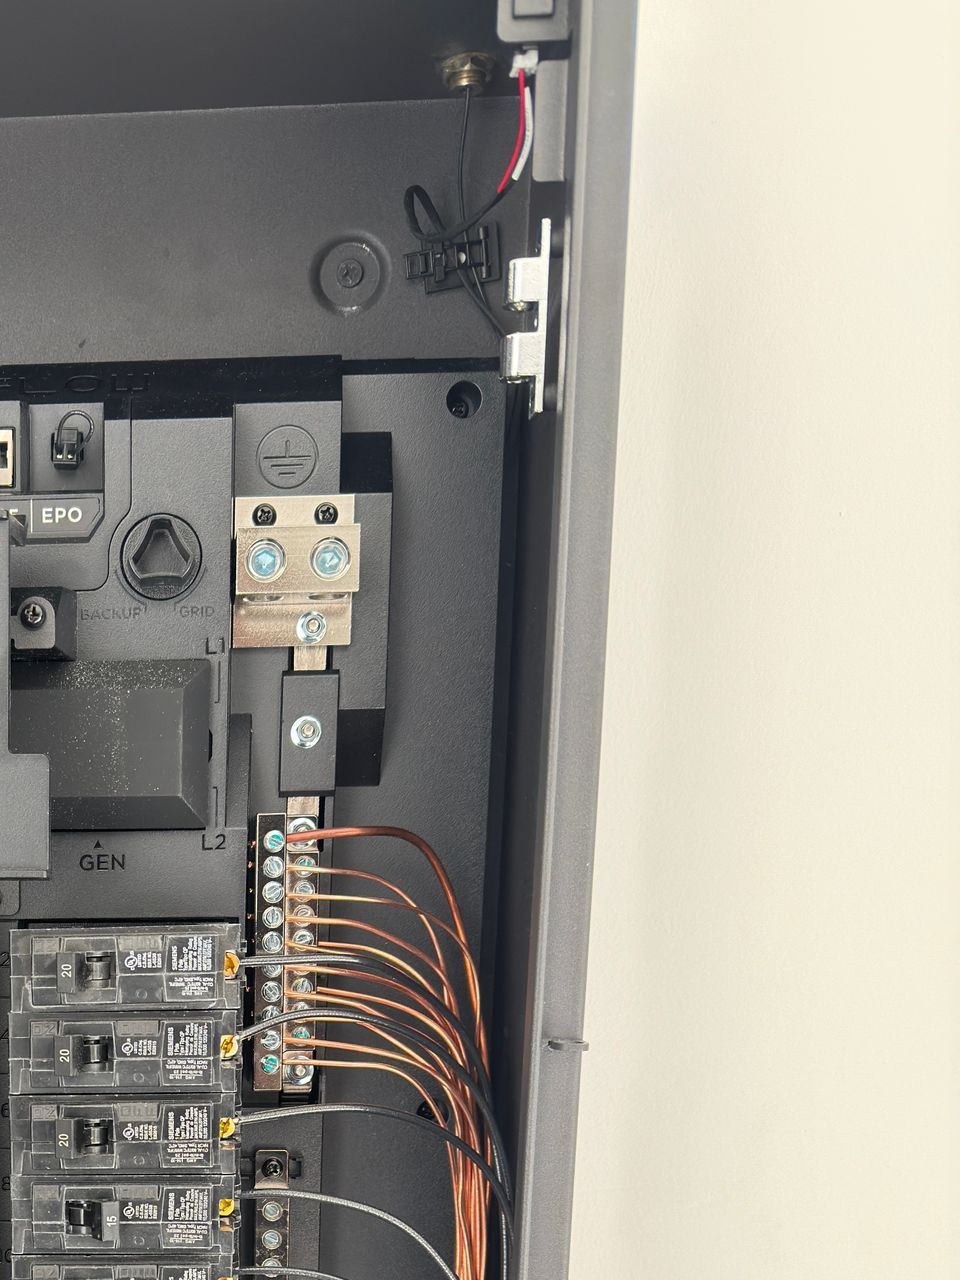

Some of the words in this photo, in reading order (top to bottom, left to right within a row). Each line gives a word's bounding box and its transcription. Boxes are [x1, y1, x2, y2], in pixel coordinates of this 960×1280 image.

[42, 508, 82, 523] EPO
[80, 607, 140, 621] BACKUP
[179, 606, 215, 618] GRID
[205, 637, 225, 655] L1
[202, 833, 226, 851] L2
[79, 854, 126, 871] GEN
[0, 952, 10, 968] 2
[61, 963, 72, 978] 20
[59, 1049, 70, 1063] 20
[1, 1103, 9, 1117] 6
[59, 1133, 69, 1147] 20
[2, 1177, 10, 1190] 8
[107, 1216, 117, 1227] 15
